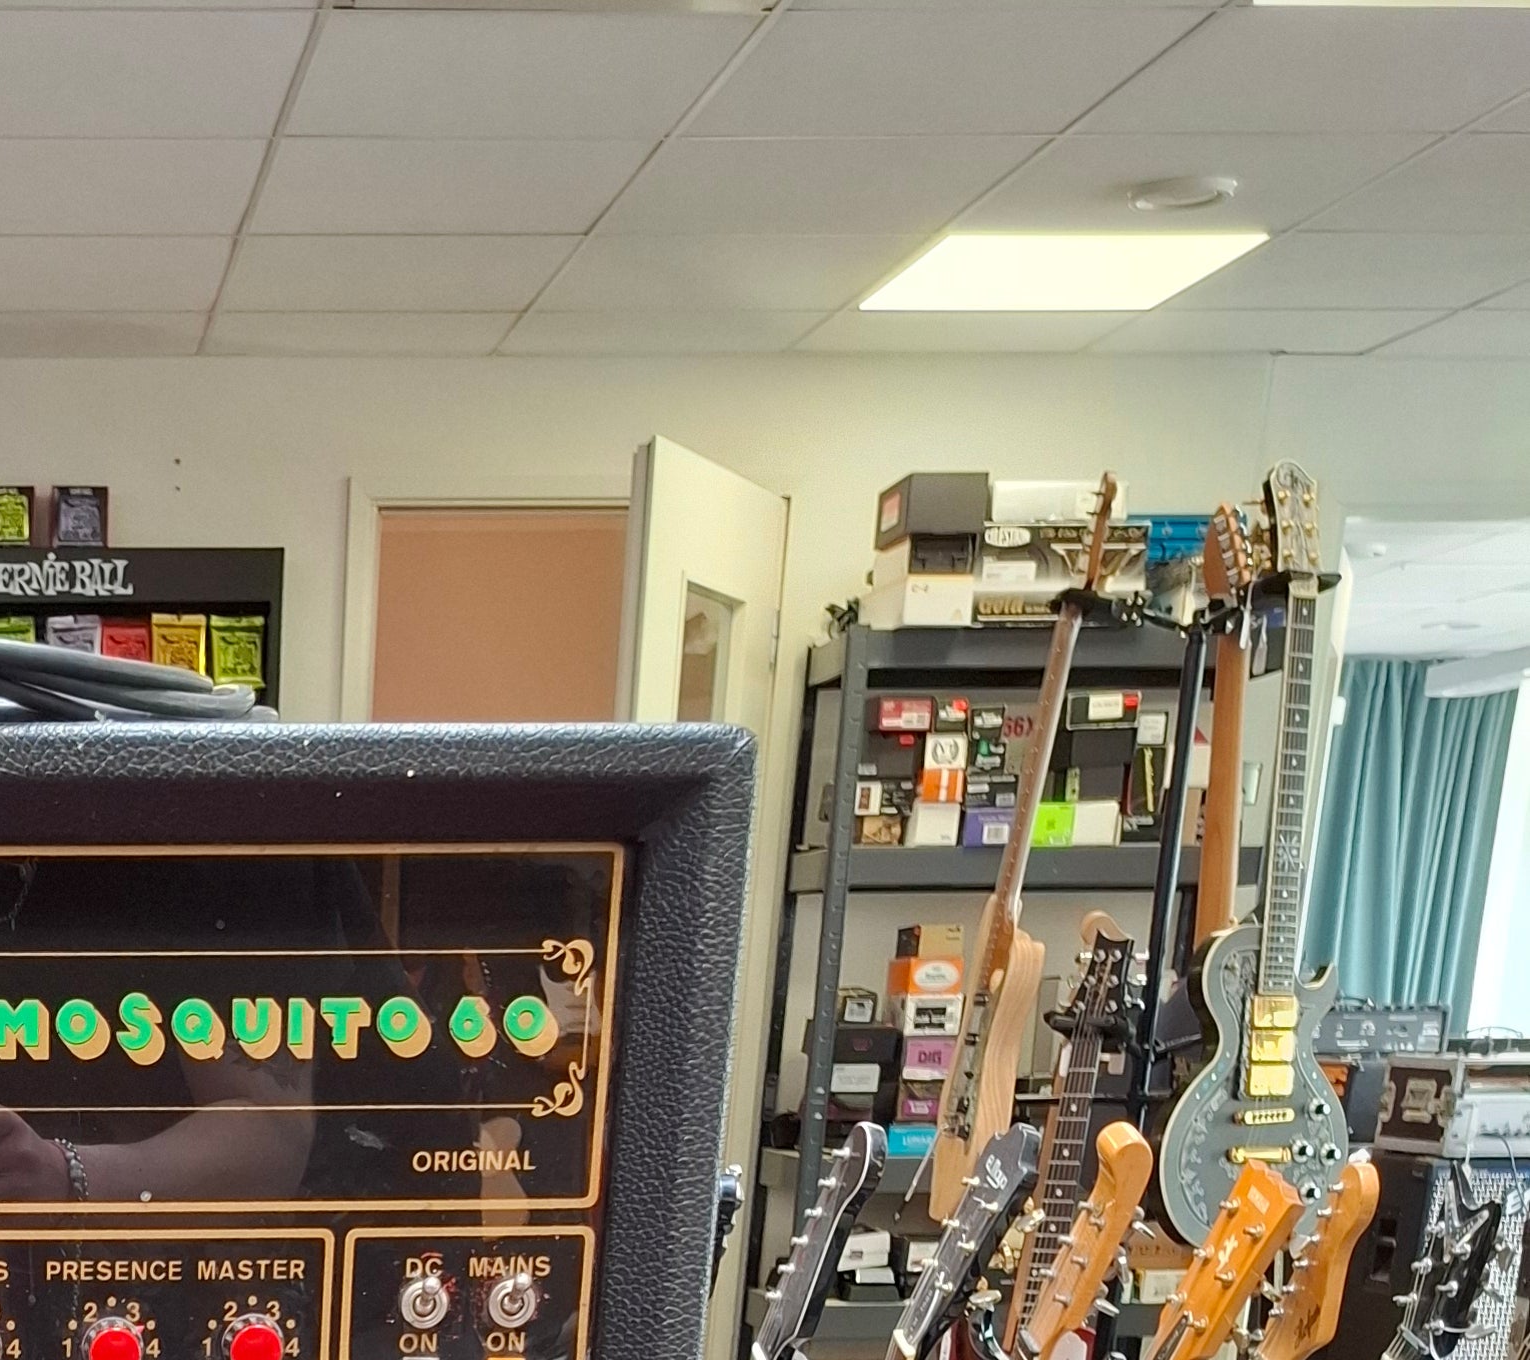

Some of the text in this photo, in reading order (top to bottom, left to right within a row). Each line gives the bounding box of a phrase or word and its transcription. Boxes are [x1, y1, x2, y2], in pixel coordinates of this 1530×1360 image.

[71, 558, 134, 596] BALL
[450, 995, 558, 1057] 60
[412, 1149, 536, 1174] ORIGINAL
[46, 1260, 182, 1281] PRESENCE
[197, 1259, 305, 1280] MASTER
[405, 1257, 443, 1278] DC
[468, 1256, 551, 1278] MAINS
[83, 1302, 98, 1322] 2
[126, 1302, 140, 1322] 3
[223, 1301, 238, 1322] 2
[266, 1301, 281, 1321] 3
[6, 1339, 21, 1359] 4
[62, 1338, 72, 1358] 1
[146, 1338, 161, 1358] 4
[202, 1337, 212, 1357] 1
[285, 1337, 300, 1357] 4
[399, 1333, 438, 1353] ON
[486, 1332, 526, 1352] ON
